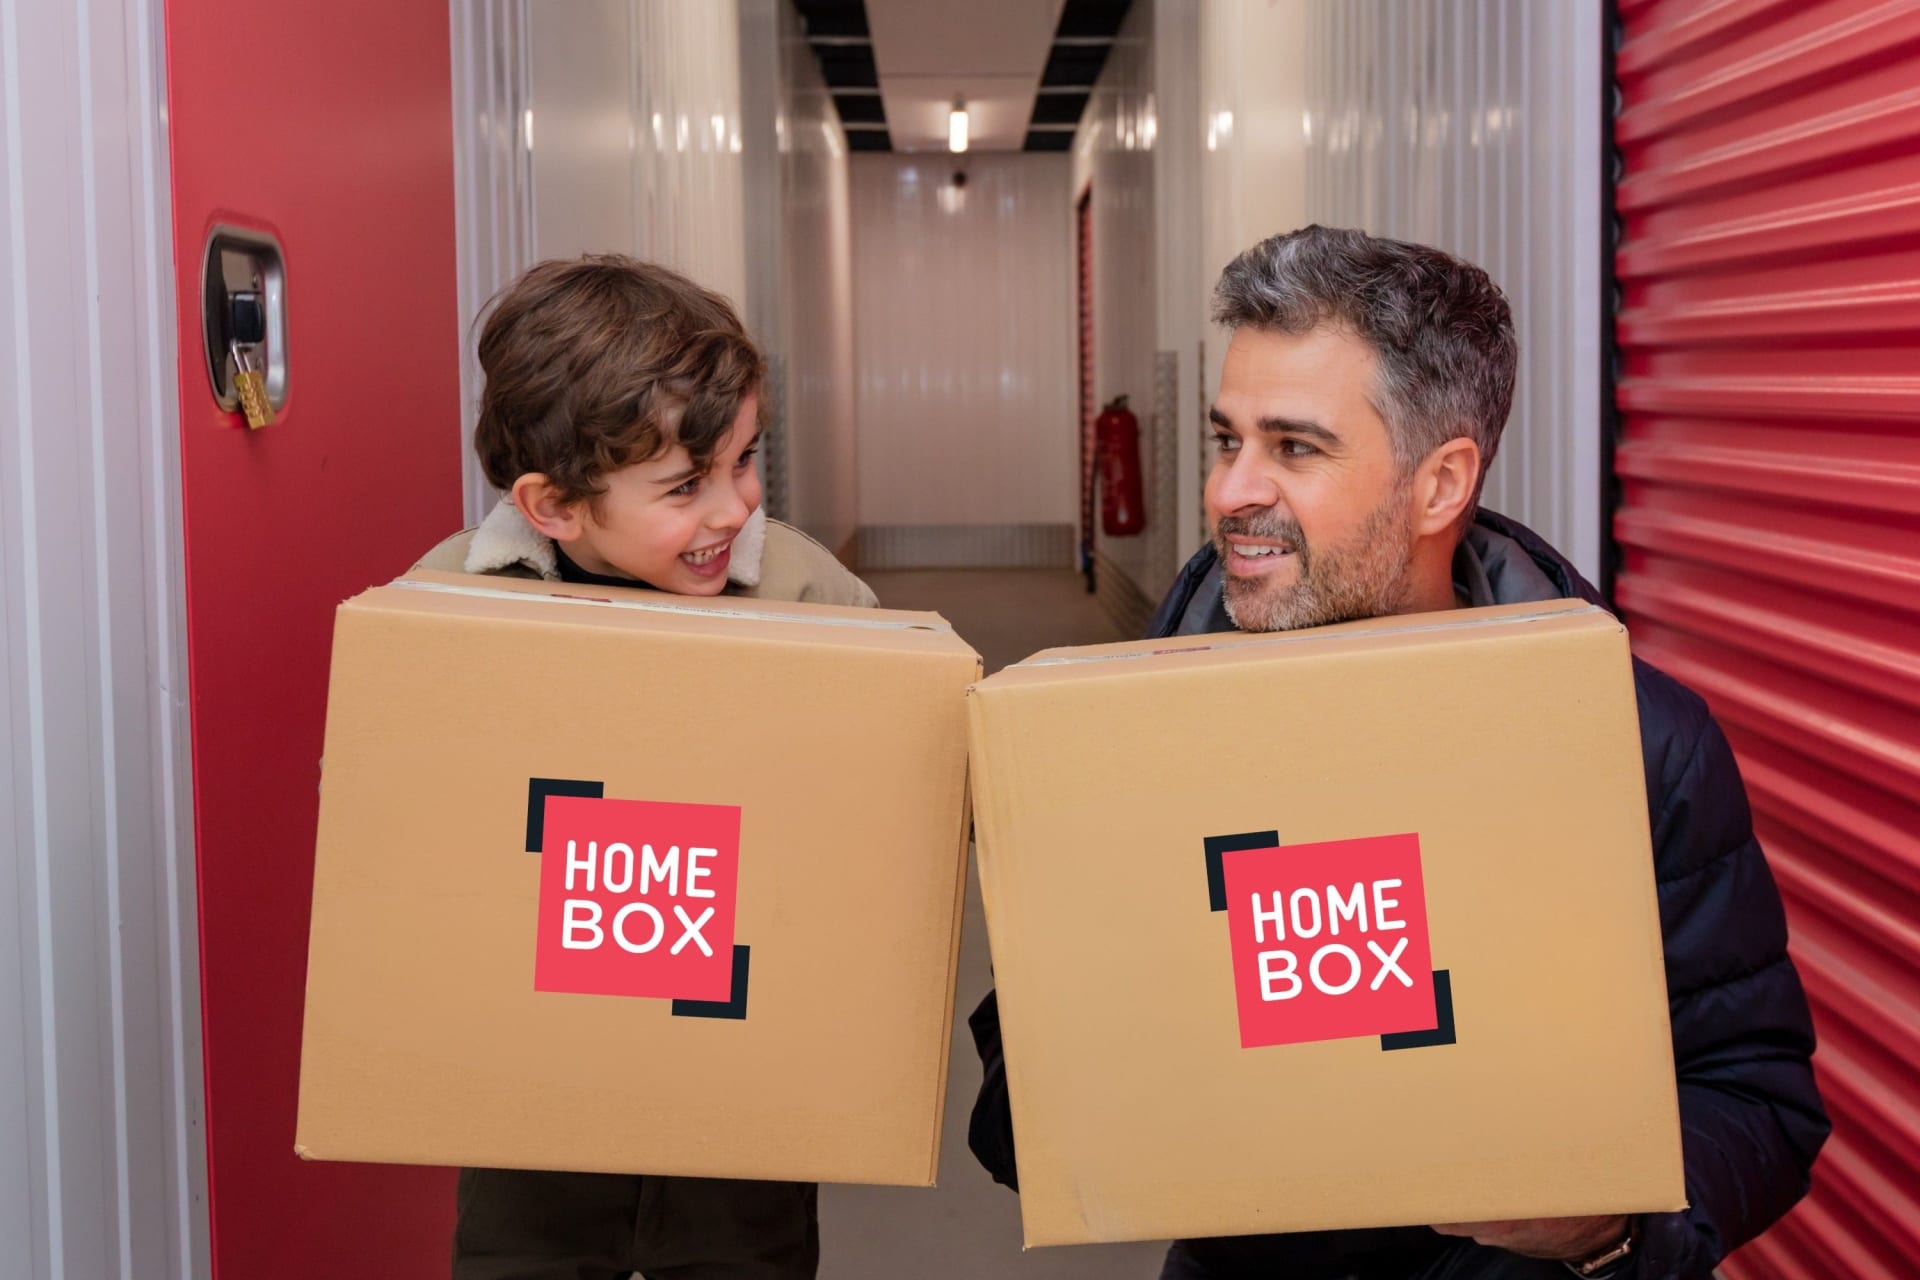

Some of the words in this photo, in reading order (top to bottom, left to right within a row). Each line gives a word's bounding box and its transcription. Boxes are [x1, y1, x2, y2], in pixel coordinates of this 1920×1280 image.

[565, 839, 718, 898] HOME
[562, 899, 715, 957] BOX
[1251, 878, 1407, 944] HOME
[1257, 937, 1414, 1002] BOX
